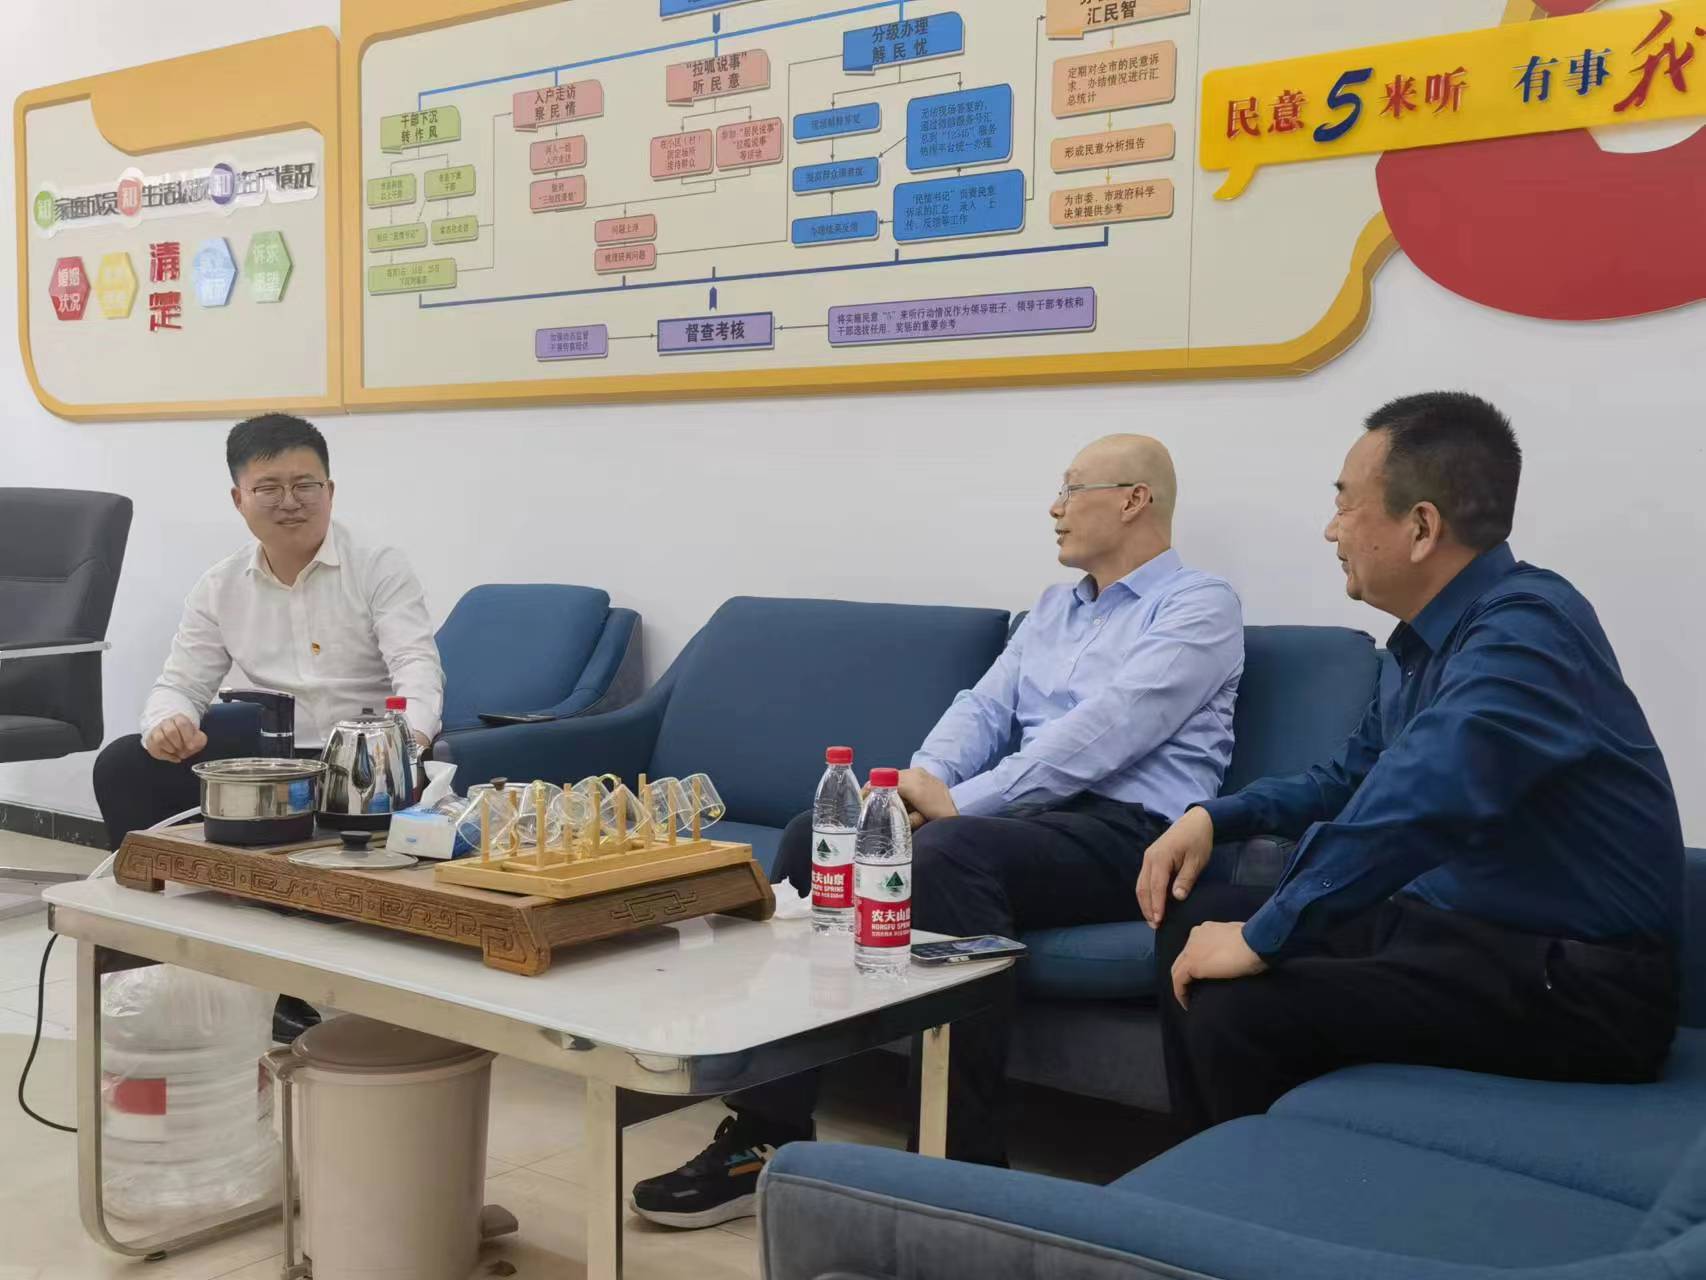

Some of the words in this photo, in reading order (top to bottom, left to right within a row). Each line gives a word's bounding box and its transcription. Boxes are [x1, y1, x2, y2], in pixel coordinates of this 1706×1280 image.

[1087, 0, 1136, 24] 汇民智
[872, 17, 928, 43] 分级办理
[872, 38, 928, 63] 解民忧
[1067, 53, 1160, 79] 定期对全市的民意诉
[535, 84, 577, 105] 入户走访
[692, 73, 740, 95] 听民意
[1067, 91, 1097, 106] 总统计
[1226, 65, 1471, 142] 民意5来听
[401, 110, 438, 129] 干部下沉
[535, 101, 577, 121] 察民情
[401, 125, 438, 143] 转作风
[1064, 137, 1145, 159] 形成民意分析报告
[1065, 185, 1156, 207] 为市委、市政府科学
[1064, 203, 1124, 219] 决策提供参考
[685, 320, 745, 343] 督查考核
